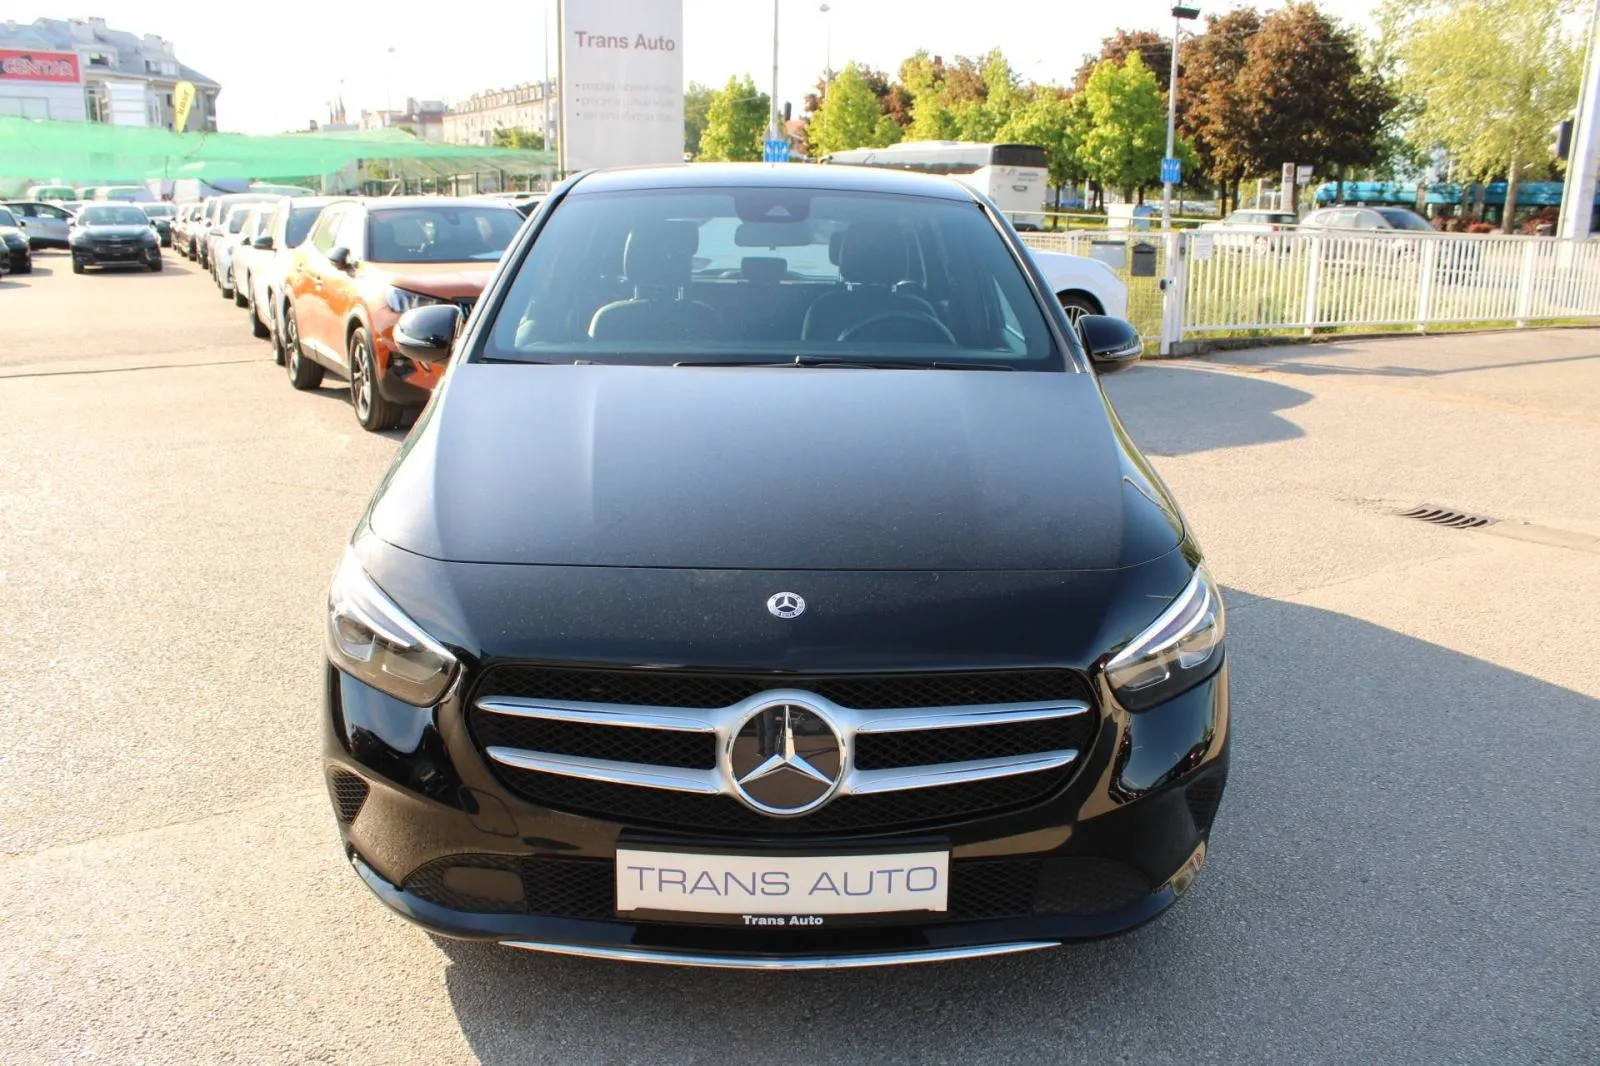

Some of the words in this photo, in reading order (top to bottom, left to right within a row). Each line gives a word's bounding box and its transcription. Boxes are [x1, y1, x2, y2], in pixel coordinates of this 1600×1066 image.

[575, 31, 629, 49] Trans
[634, 33, 675, 51] Auto
[627, 866, 790, 896] TRANS
[808, 866, 937, 896] AUTO
[742, 915, 785, 925] Trans
[789, 915, 824, 925] Auto
